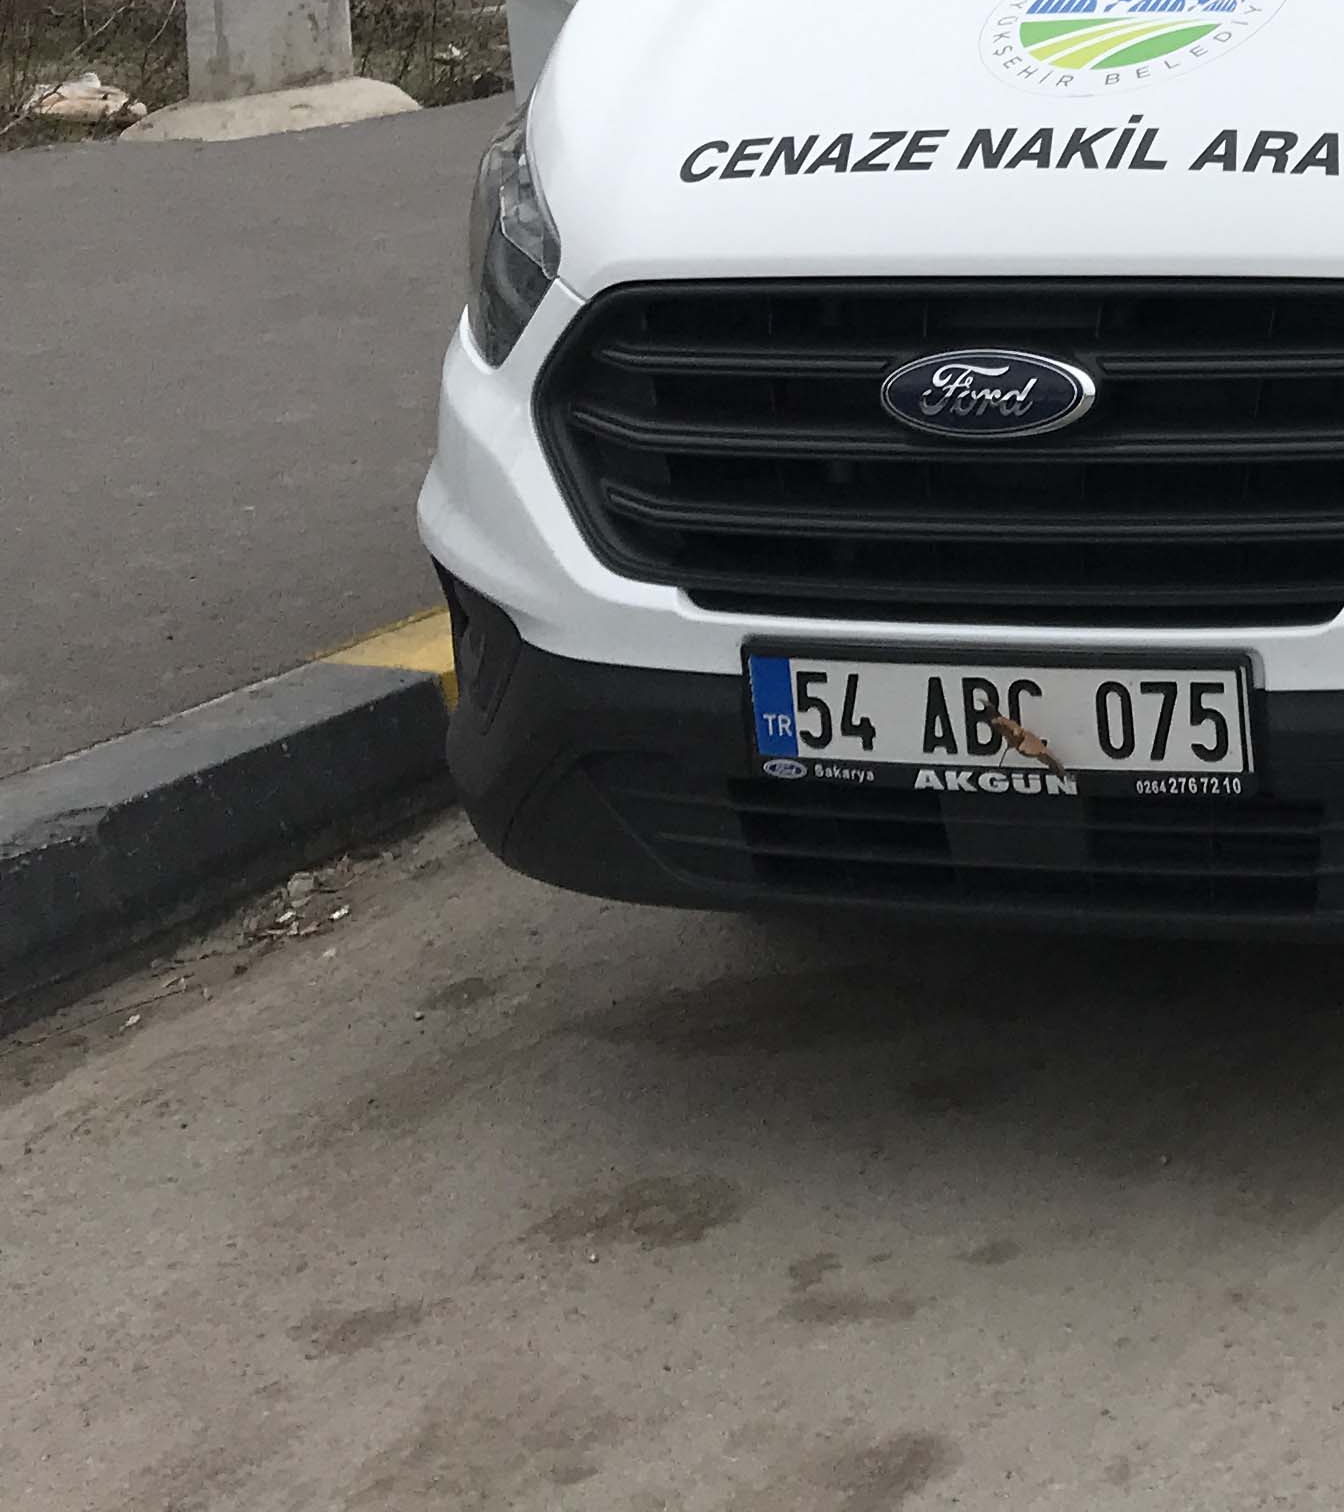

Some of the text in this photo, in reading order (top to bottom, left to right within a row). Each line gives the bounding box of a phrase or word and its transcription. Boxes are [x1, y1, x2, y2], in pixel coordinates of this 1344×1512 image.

[679, 128, 950, 183] CENAZE
[956, 114, 1168, 170] NAKİL
[918, 363, 1039, 417] Ford
[762, 713, 793, 737] TR
[796, 671, 1229, 762] 54 ABC 075
[814, 764, 875, 783] Sakarya
[914, 769, 1078, 795] AKGÜN
